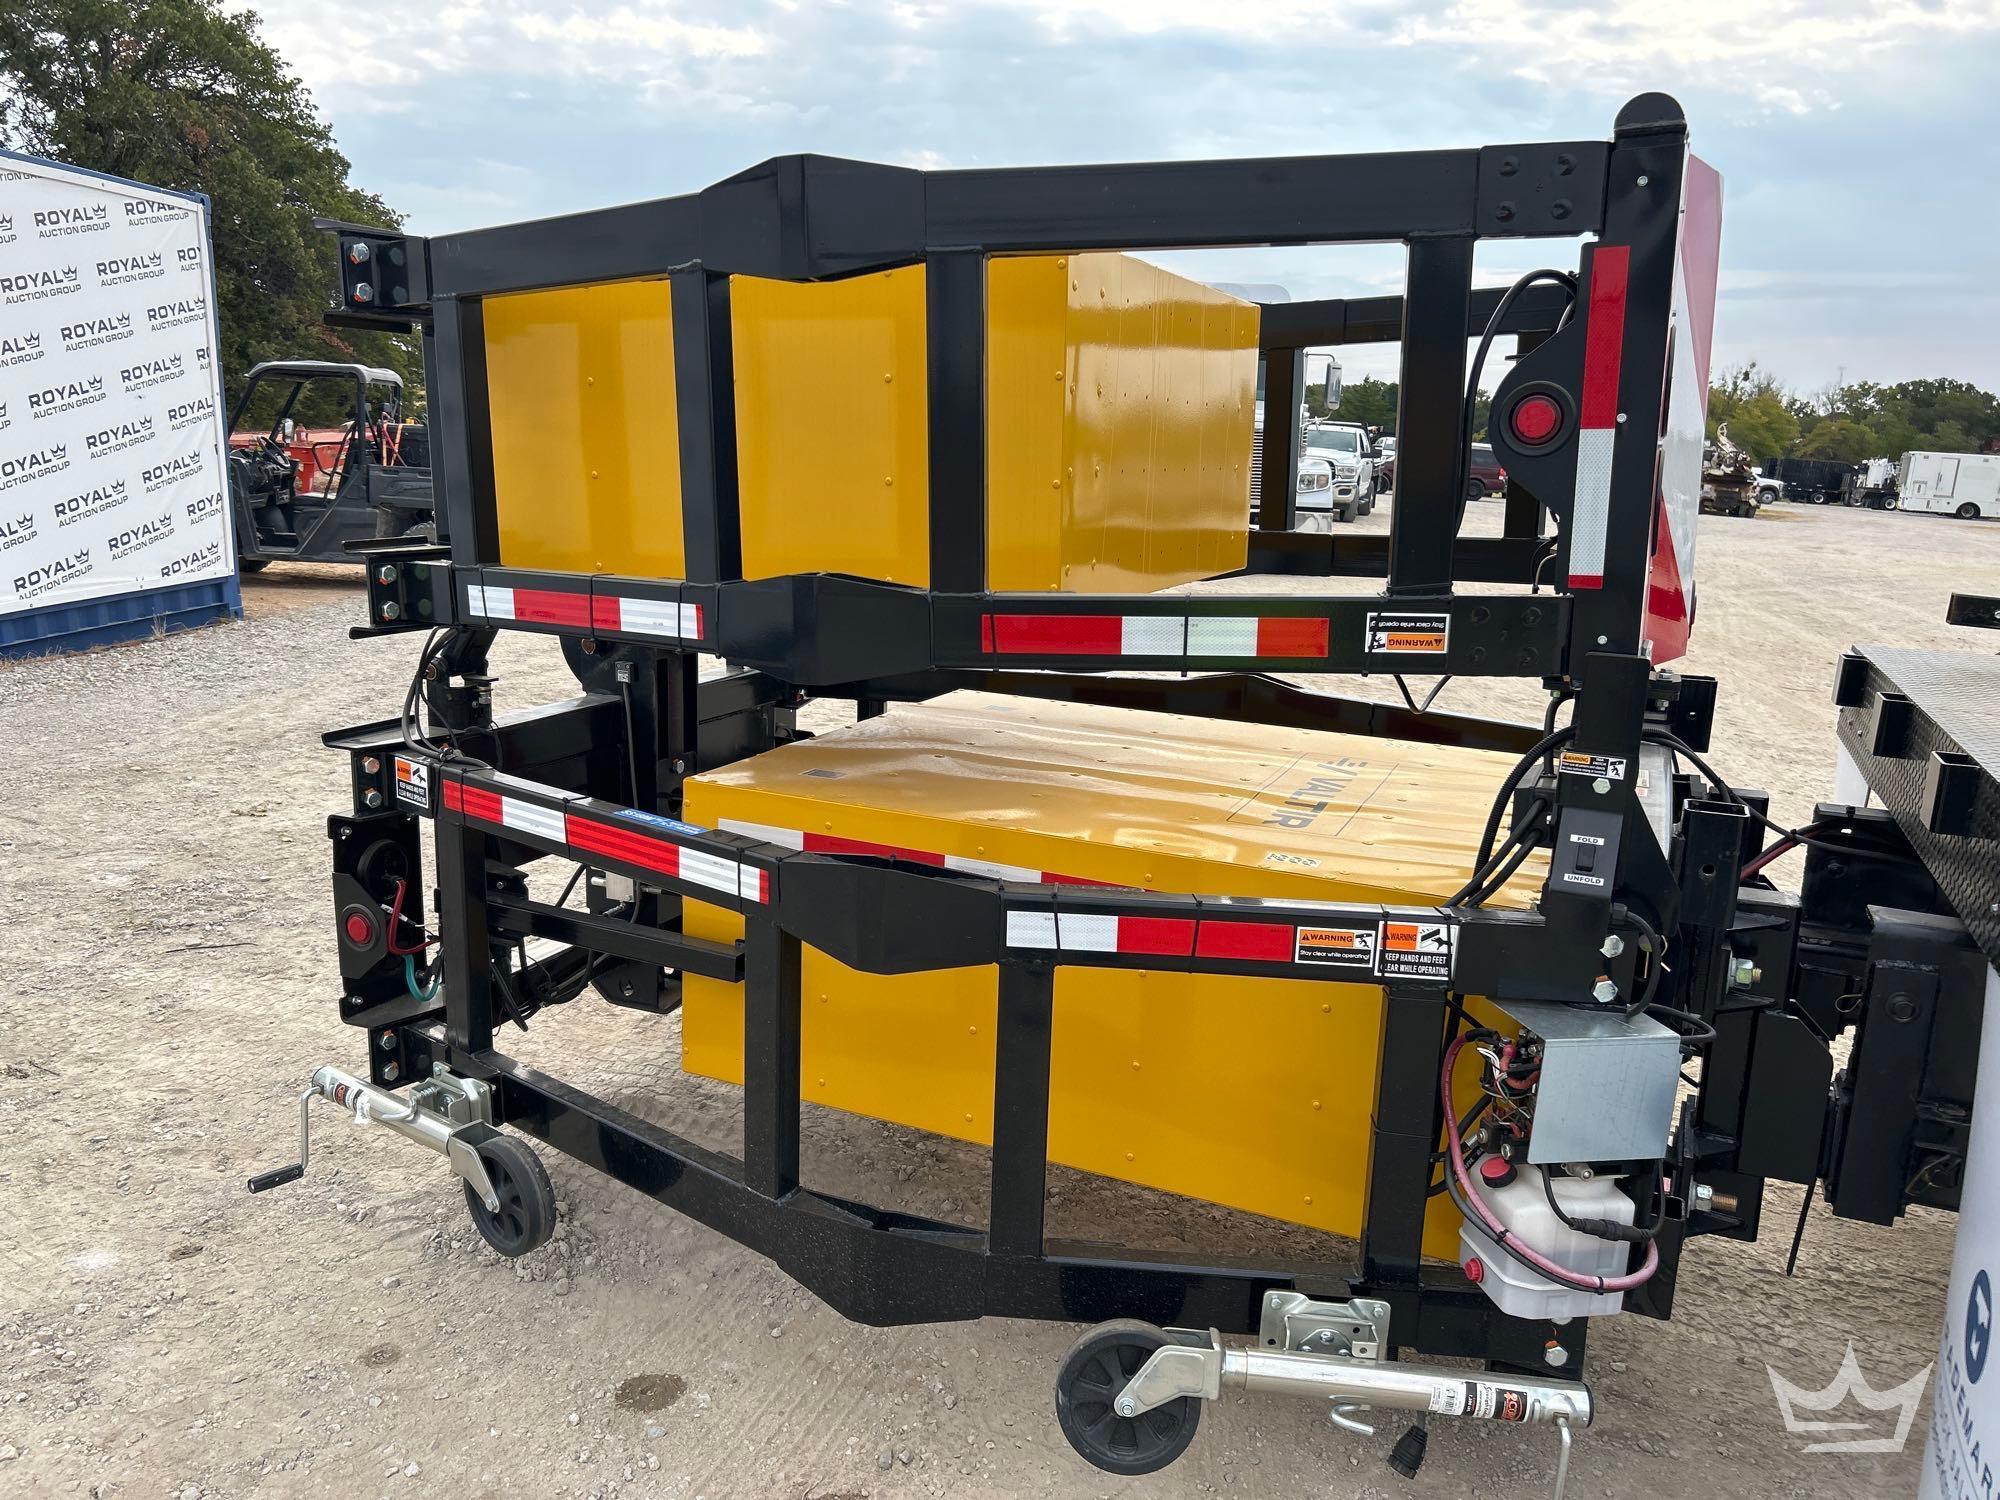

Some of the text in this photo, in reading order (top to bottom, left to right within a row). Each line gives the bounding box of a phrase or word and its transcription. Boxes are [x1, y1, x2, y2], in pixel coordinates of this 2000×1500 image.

[34, 208, 93, 226] ROYAL
[128, 212, 189, 226] AUCTION GROUP
[39, 222, 110, 239] AUCTION GROUP
[96, 256, 150, 276] ROYAL
[0, 270, 63, 293] ROYAL
[101, 269, 165, 287] AUCTION GROUP
[6, 285, 82, 305] AUCTION GROUP
[147, 300, 195, 321] ROYAL
[61, 317, 113, 341] ROYAL
[152, 318, 183, 332] AUCTION
[65, 330, 134, 352] AUCTION GROUP
[10, 350, 44, 365] GROUP
[120, 359, 170, 383] ROYAL
[125, 370, 184, 393] AUCTION GROUP
[28, 382, 89, 408] ROYAL
[33, 393, 106, 420] AUCTION GROUP
[168, 398, 214, 422] ROYAL
[172, 415, 202, 431] AUCTION
[86, 422, 141, 449] ROYAL
[90, 432, 156, 460] AUCTION GROUP
[0, 451, 52, 479] OYAL
[0, 461, 70, 491] UCTION GROUP
[142, 456, 191, 484] ROYAL
[146, 465, 203, 494] AUCTION GROUP
[54, 487, 112, 518] ROYAL
[59, 495, 128, 528] AUCTION GROUP
[190, 509, 221, 526] AUCTION
[3, 530, 38, 550] GROUP
[108, 520, 160, 551] ROYAL
[112, 528, 175, 561] AUCTION GROUP
[14, 556, 76, 592] ROYAL
[160, 549, 208, 578] ROYAL
[197, 556, 221, 572] GROUP
[19, 564, 92, 600] AUCTION GROUP
[1388, 638, 1434, 646] WARNING
[1577, 836, 1599, 844] FOLD
[1567, 874, 1601, 884] UNFOLD
[1310, 933, 1353, 943] WARNING
[1390, 932, 1417, 942] WARNING
[1400, 954, 1420, 962] HANDS
[1420, 955, 1432, 963] AND
[1432, 956, 1447, 964] FEET
[1400, 964, 1418, 973] WHILE
[1418, 965, 1448, 976] OPERATING
